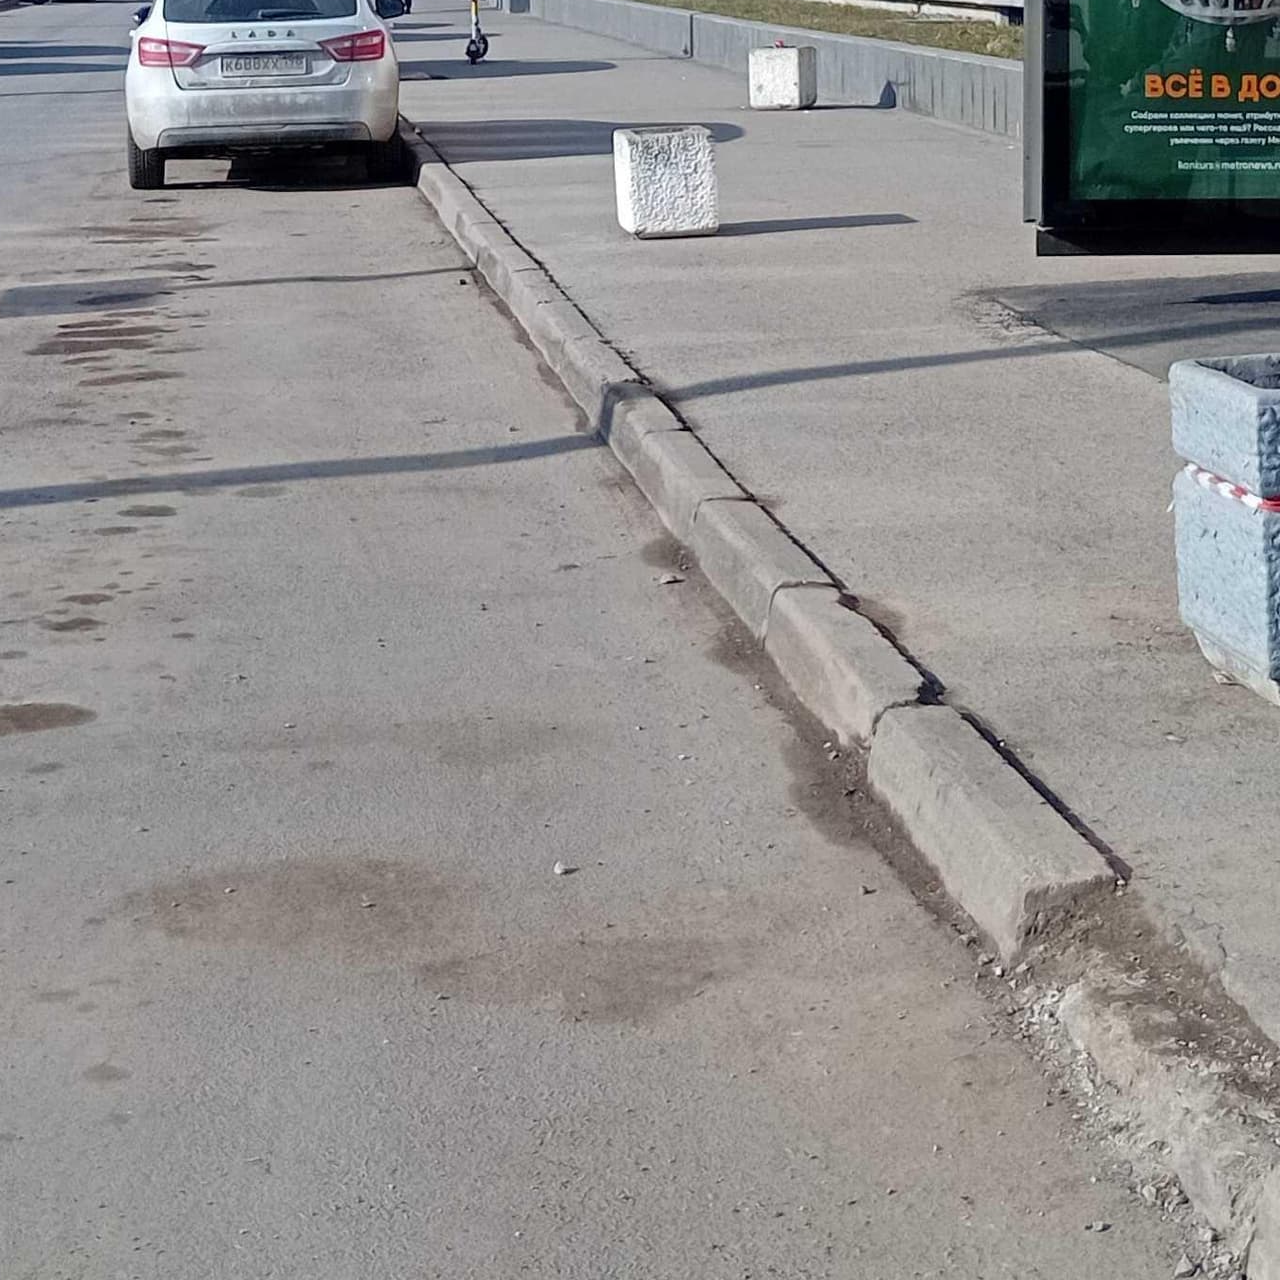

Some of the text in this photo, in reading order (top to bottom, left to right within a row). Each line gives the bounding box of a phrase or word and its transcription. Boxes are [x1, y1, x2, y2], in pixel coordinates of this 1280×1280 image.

[231, 30, 295, 38] LADA
[1144, 69, 1203, 98] ВСЁ
[1211, 74, 1231, 98] В
